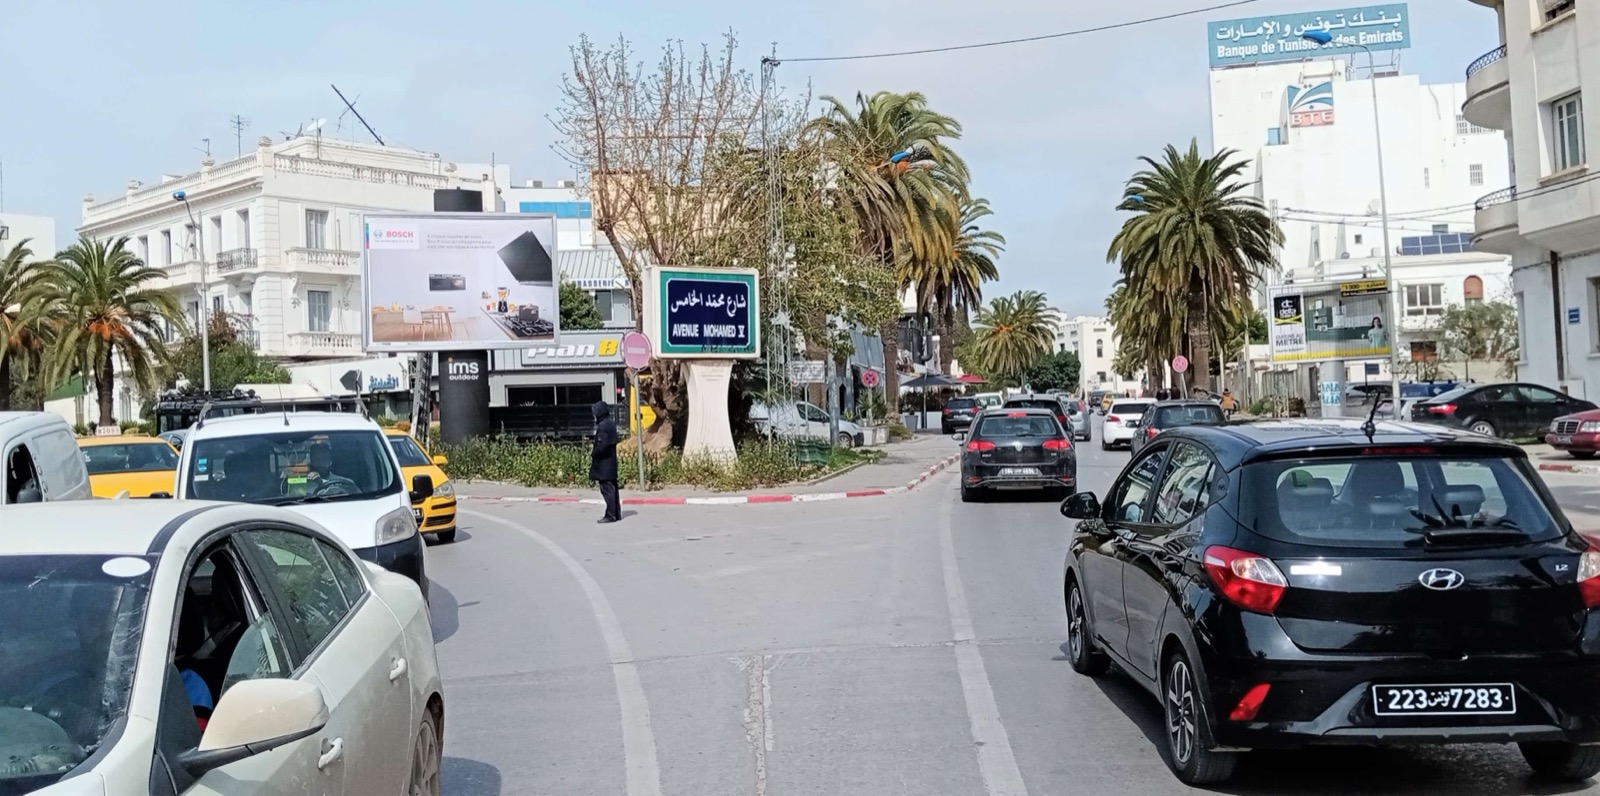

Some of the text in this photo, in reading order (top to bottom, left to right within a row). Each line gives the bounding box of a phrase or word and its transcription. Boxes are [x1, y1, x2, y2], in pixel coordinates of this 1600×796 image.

[1293, 13, 1346, 36] تونس
[1348, 11, 1402, 28] بنك
[1282, 23, 1291, 37] و
[1217, 44, 1258, 59] Banque
[1261, 40, 1275, 54] de
[1277, 37, 1319, 52] Tunisie
[1336, 34, 1356, 47] des
[1358, 29, 1404, 45] Emirats
[1291, 110, 1333, 126] BTE
[386, 230, 414, 239] BOSCH
[576, 279, 615, 287] RASSERIE
[670, 289, 703, 313] الخامس
[726, 293, 747, 317] شارع
[672, 323, 745, 338] AVENUE MOHAMED V
[448, 357, 480, 375] ims
[1388, 688, 1503, 709] 223 تونس 7283
